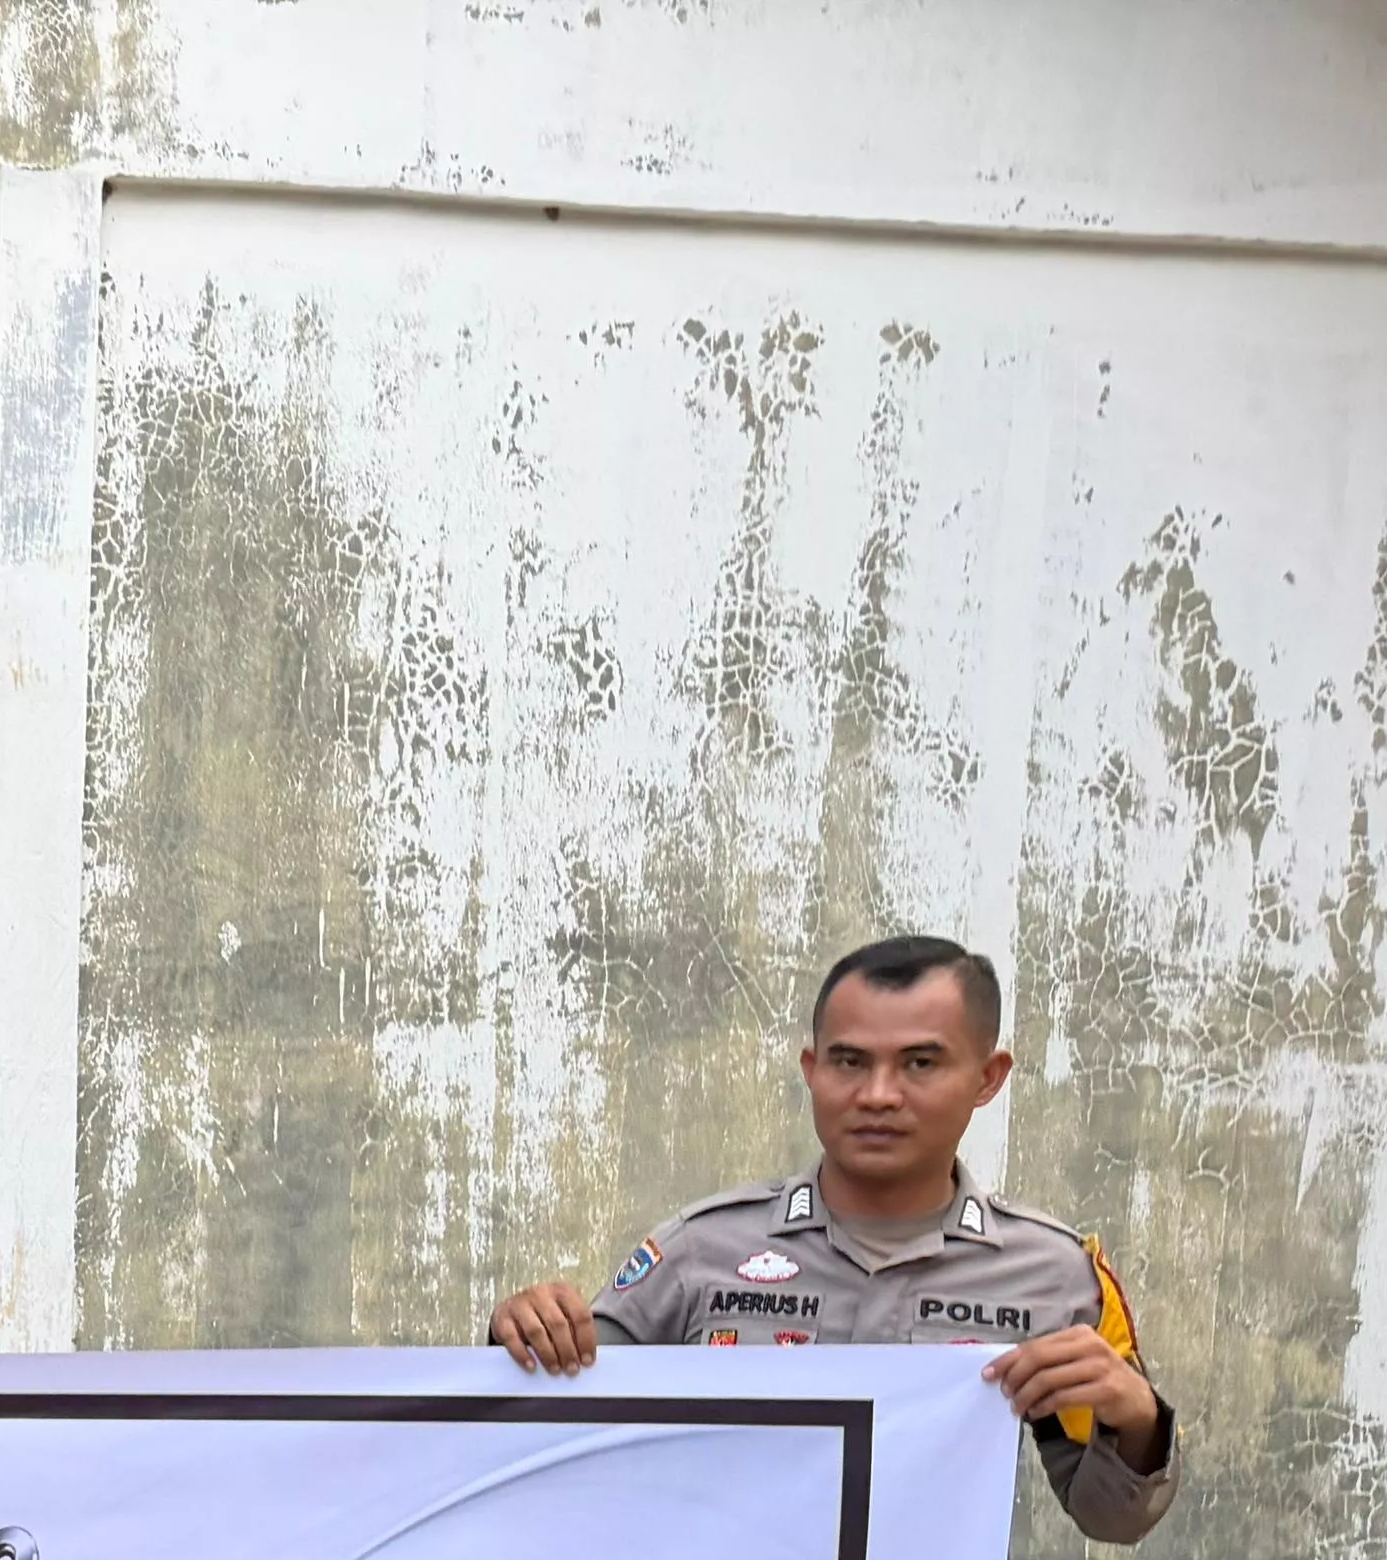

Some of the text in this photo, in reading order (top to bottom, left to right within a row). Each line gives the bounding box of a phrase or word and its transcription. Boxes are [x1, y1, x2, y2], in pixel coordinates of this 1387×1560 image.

[709, 1290, 820, 1318] APERIUS H
[919, 1297, 1032, 1334] POLRI
